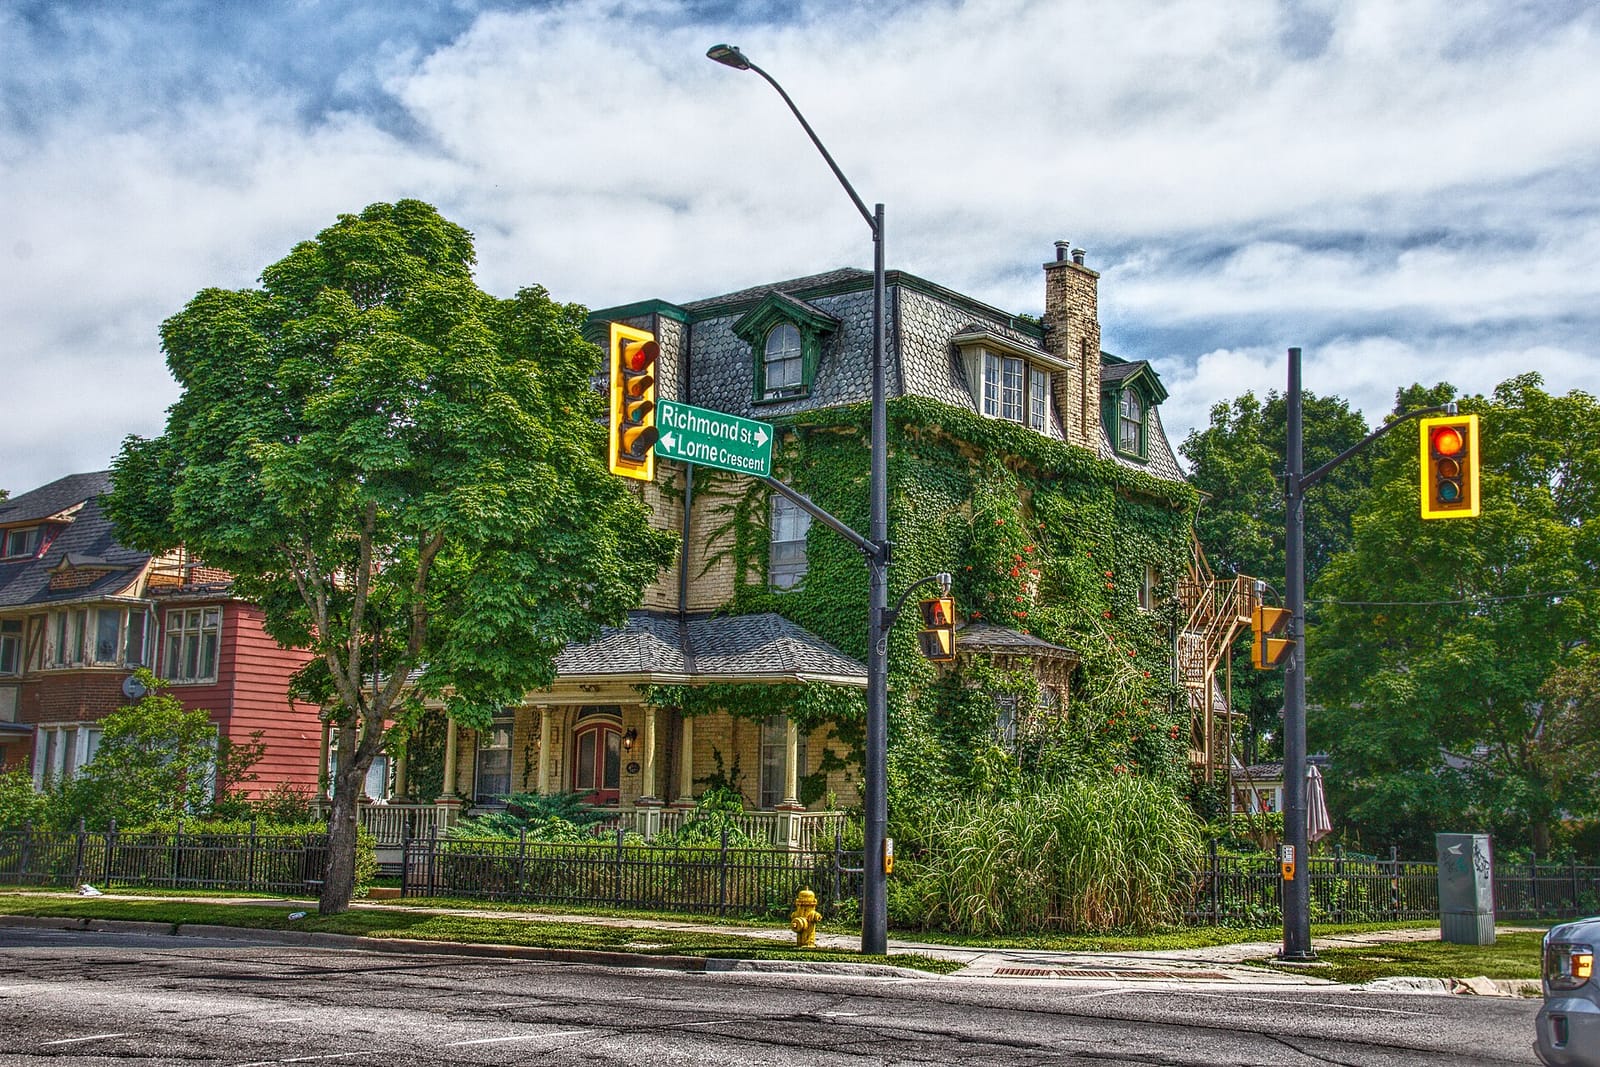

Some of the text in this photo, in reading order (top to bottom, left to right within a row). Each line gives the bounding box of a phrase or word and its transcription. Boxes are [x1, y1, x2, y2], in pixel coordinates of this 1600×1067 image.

[662, 404, 738, 440] Richmond
[677, 434, 764, 471] Lorne Crescent
